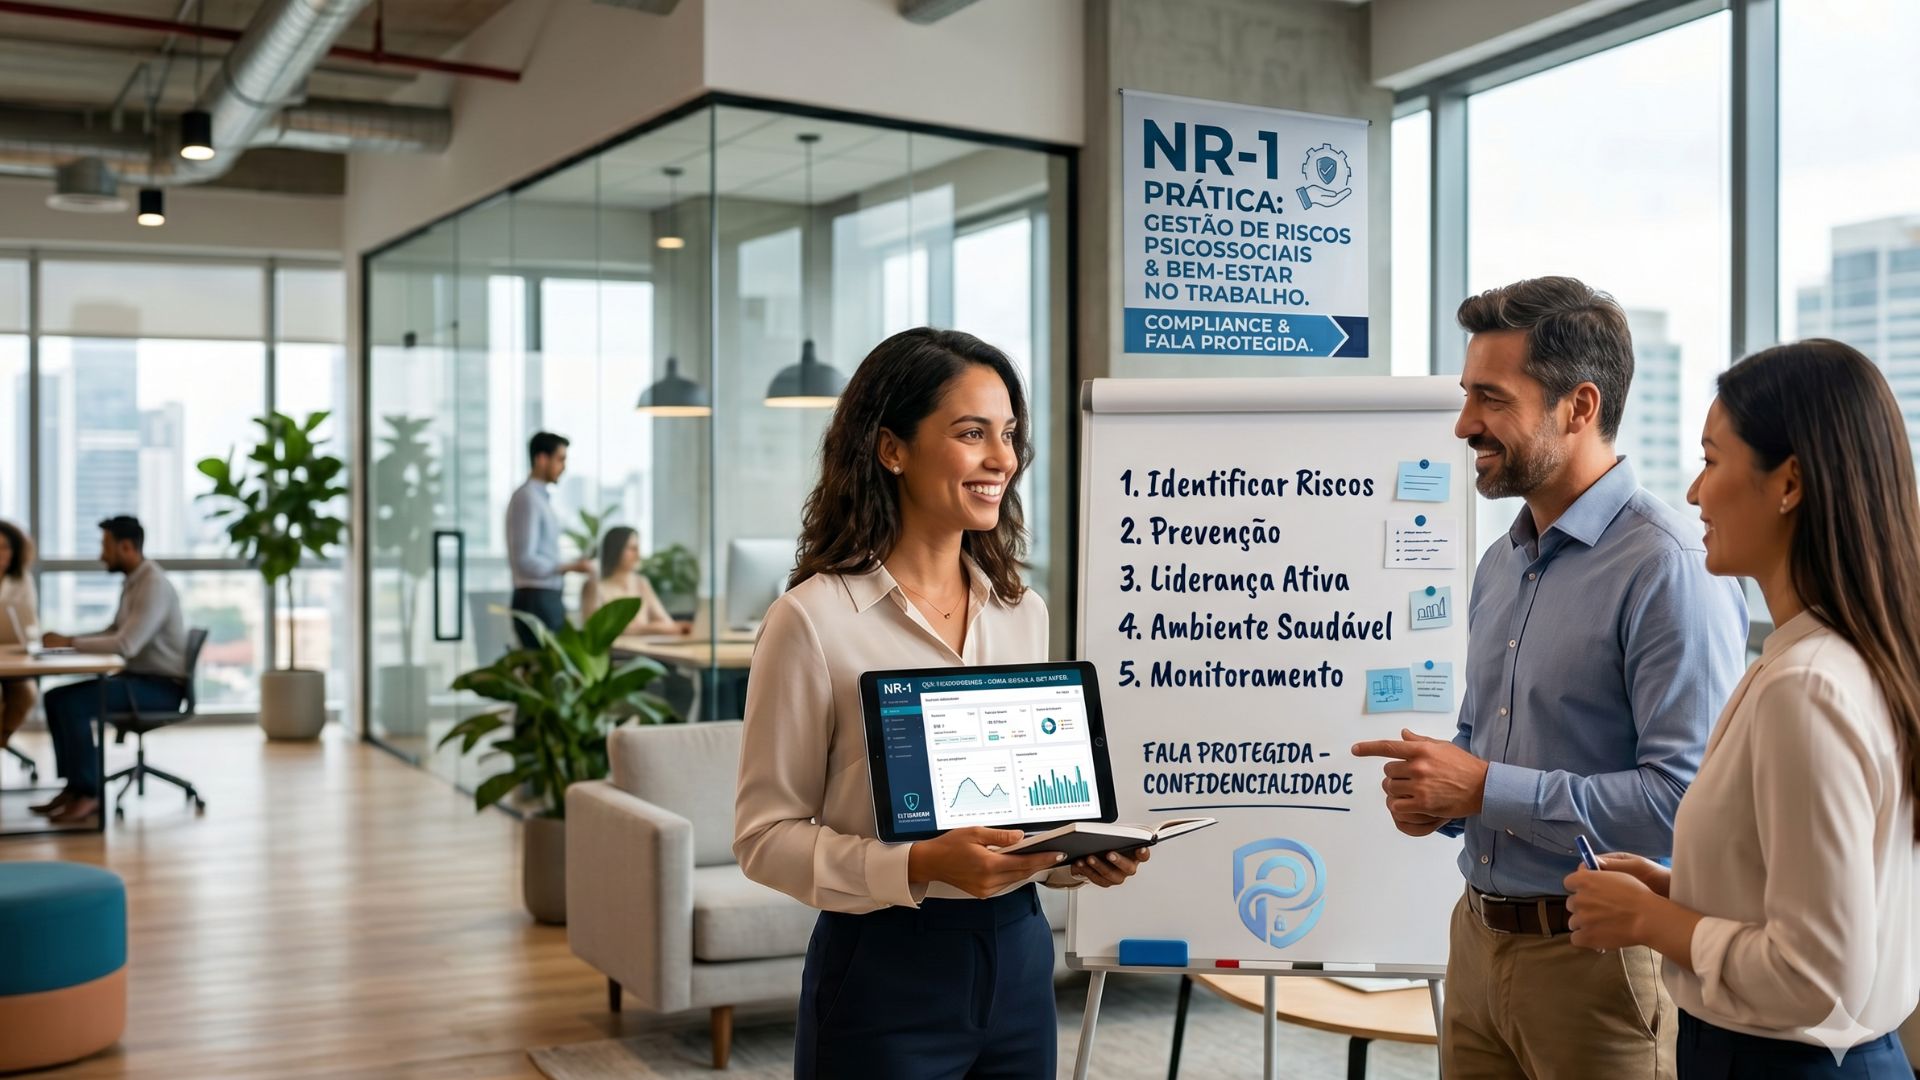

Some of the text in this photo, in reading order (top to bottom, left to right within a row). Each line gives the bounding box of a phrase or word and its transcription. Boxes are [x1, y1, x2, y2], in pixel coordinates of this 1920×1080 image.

[1143, 118, 1279, 180] NR-1
[1144, 179, 1284, 215] PRÁTICA:
[1144, 213, 1351, 245] GESTÃO DE RISCOS
[1144, 236, 1312, 263] PSICOSSOCIAIS
[1144, 259, 1293, 284] & BEM-ESTAR
[1144, 282, 1310, 306] NO TRABALHO.
[1144, 314, 1290, 333] COMPLIANCE &
[1145, 333, 1314, 353] FALA PROTEGIDA.
[1120, 468, 1375, 498] 1. Identificar Riscos
[1120, 516, 1281, 552] 2. Prevenção
[1120, 563, 1350, 599] 3. Liderança Ativa
[1118, 610, 1393, 641] 4. Ambiente Saudável
[1118, 660, 1344, 688] 5. Monitoramento
[884, 683, 912, 694] NR-1
[1143, 741, 1192, 763] FALA
[1197, 741, 1314, 764] PROTEGIDA
[1143, 772, 1354, 795] CONFIDENCIALIDADE
